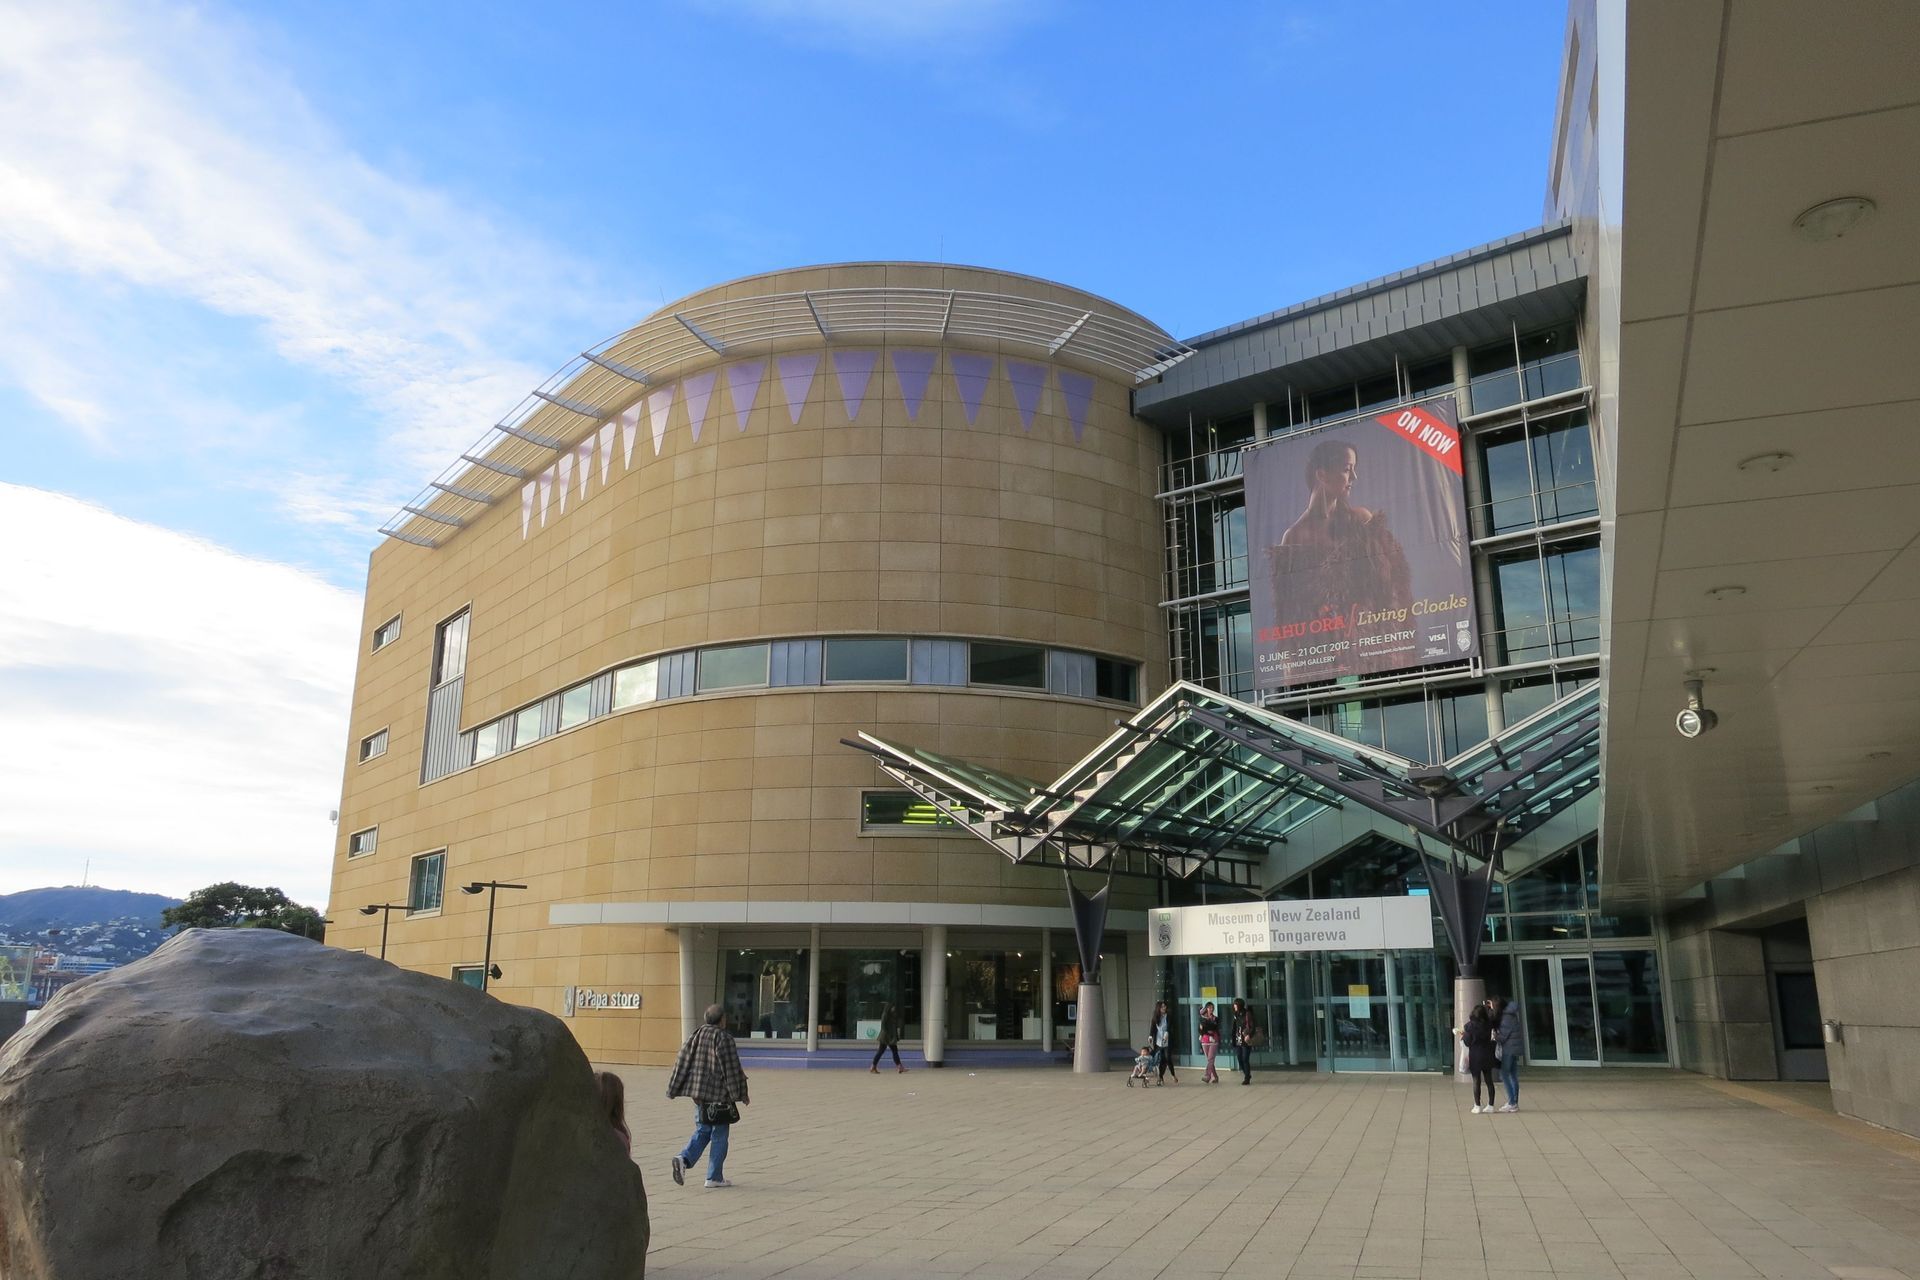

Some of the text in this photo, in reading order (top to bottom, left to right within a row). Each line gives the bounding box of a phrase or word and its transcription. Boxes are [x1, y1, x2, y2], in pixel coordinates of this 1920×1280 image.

[1397, 411, 1456, 455] ON NOW
[1310, 615, 1345, 634] ORA
[1357, 607, 1408, 626] Living
[1411, 593, 1468, 615] Cloaks
[1260, 654, 1265, 663] 8
[1267, 651, 1290, 662] JUNE
[1298, 648, 1307, 657] 21
[1309, 645, 1328, 655] OCT
[1329, 641, 1350, 652] 2012
[1359, 635, 1382, 647] FREE
[1384, 630, 1416, 643] ENTRY
[1428, 633, 1446, 642] VISA
[1260, 655, 1336, 673] VISA PLATINUM GALLERY
[1208, 906, 1360, 926] Museum of New Zealand
[1223, 929, 1346, 947] Te Papa Tongarewa
[577, 989, 640, 1010] Te Papa store
